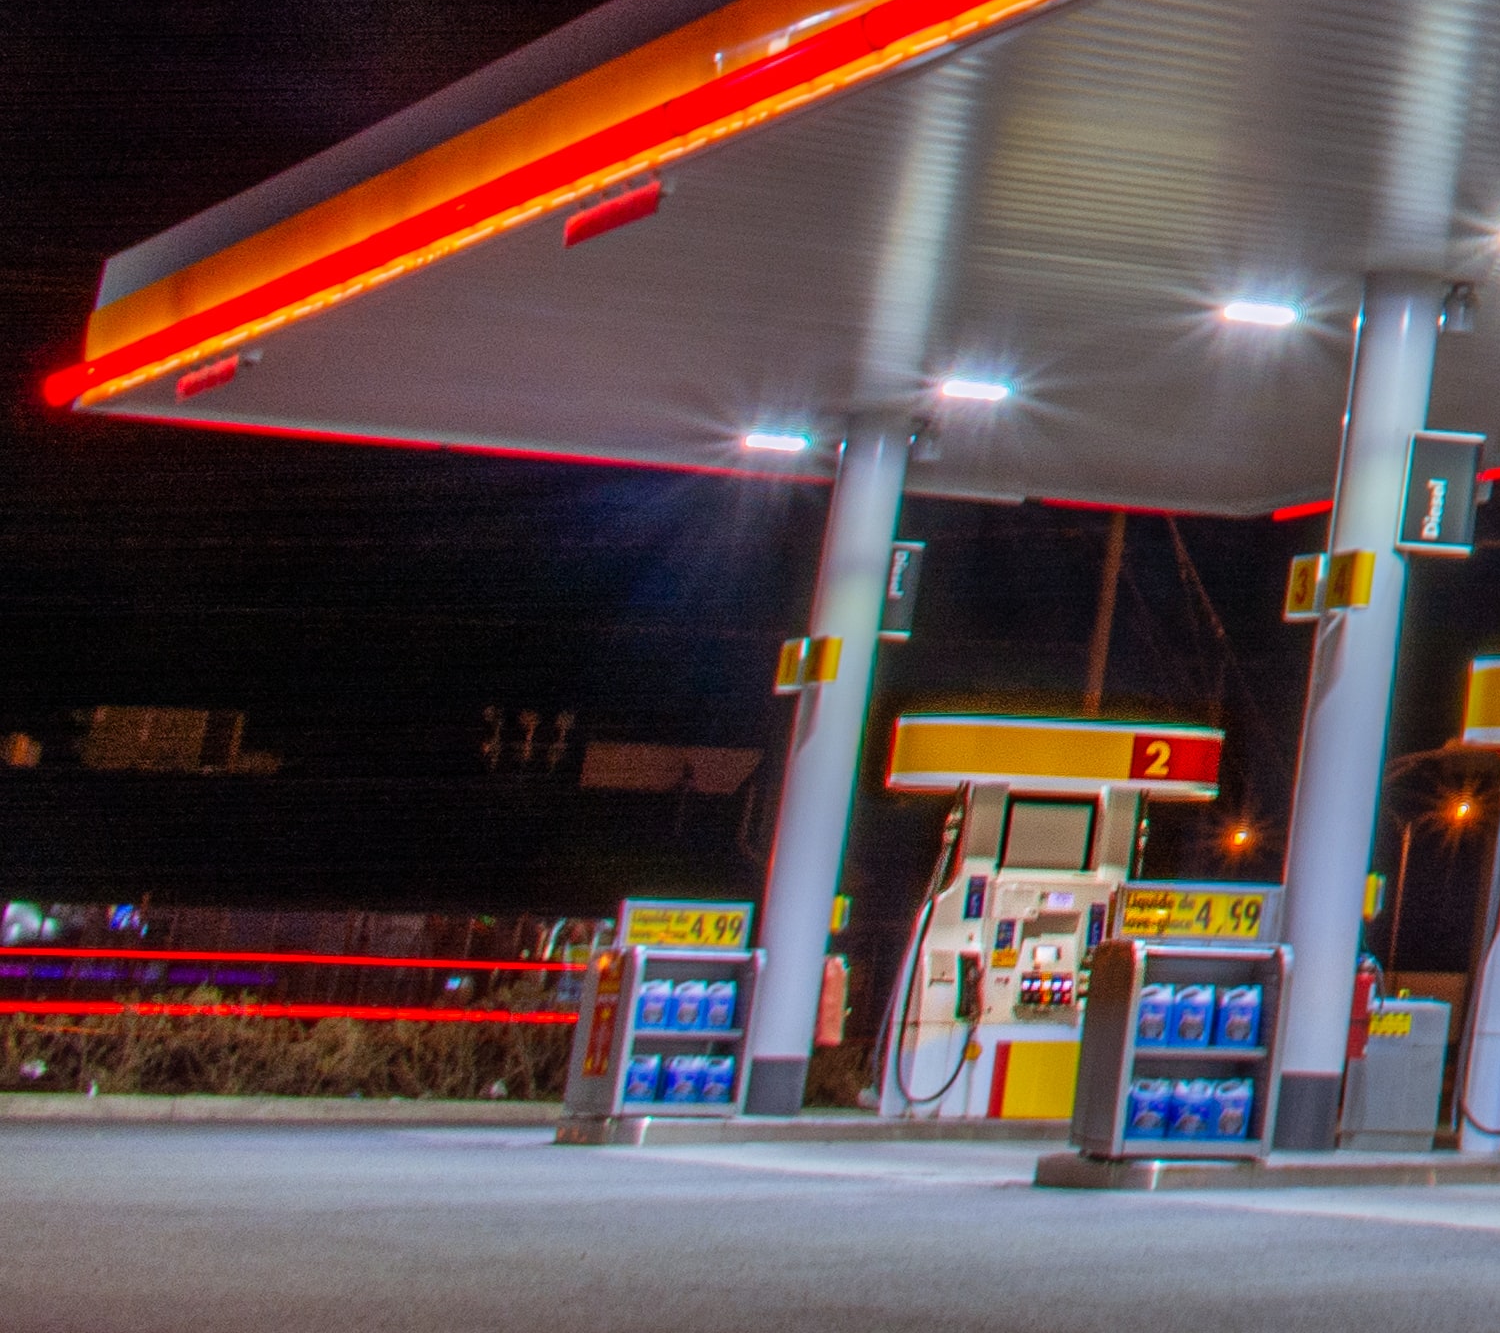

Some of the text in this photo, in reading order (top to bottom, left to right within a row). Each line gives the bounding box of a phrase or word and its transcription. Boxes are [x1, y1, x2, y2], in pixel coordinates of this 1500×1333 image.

[1421, 478, 1448, 541] Diesel
[1295, 566, 1309, 605] 3
[1333, 562, 1348, 600] 4
[1144, 740, 1171, 777] 2
[691, 912, 743, 945] 4,99
